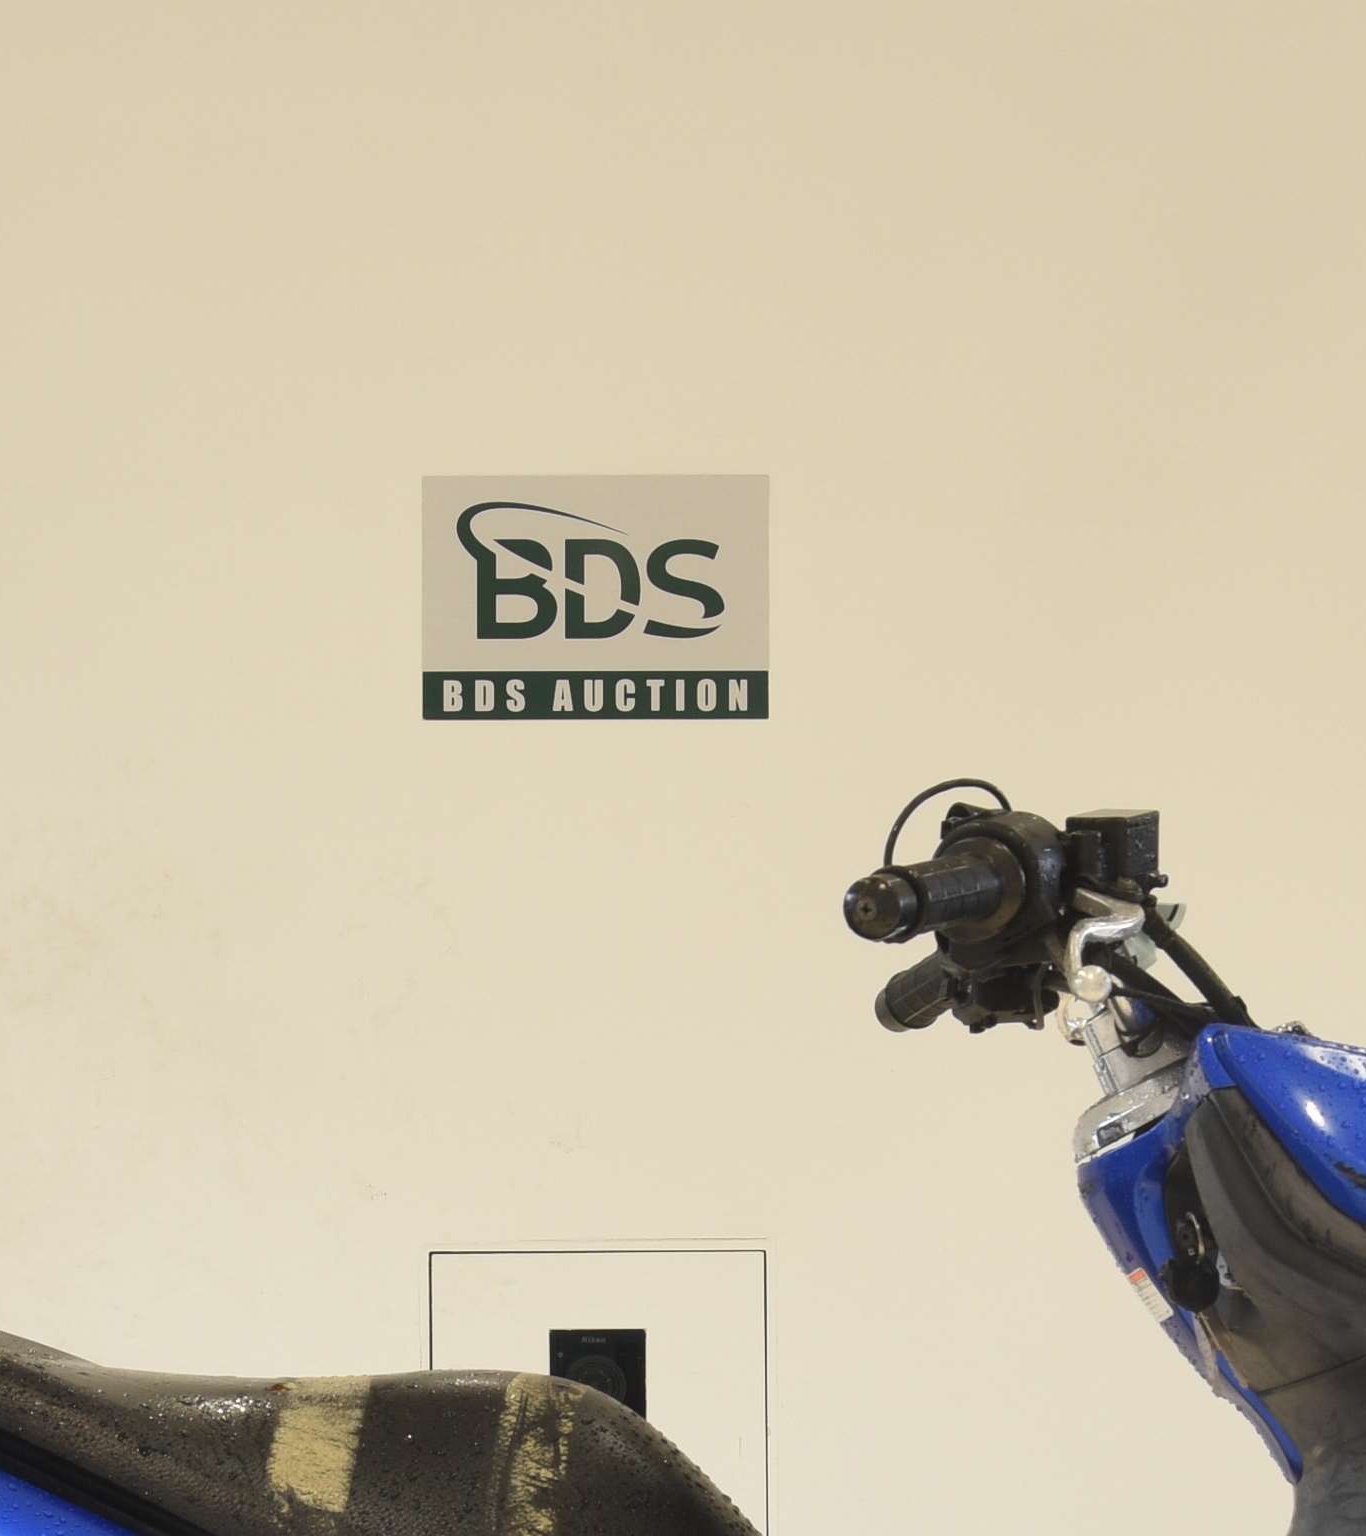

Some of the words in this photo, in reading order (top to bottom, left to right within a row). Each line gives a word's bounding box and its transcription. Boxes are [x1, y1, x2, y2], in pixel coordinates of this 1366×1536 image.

[457, 501, 725, 639] BDS
[442, 678, 526, 713] BDS
[552, 678, 749, 713] AUCTION
